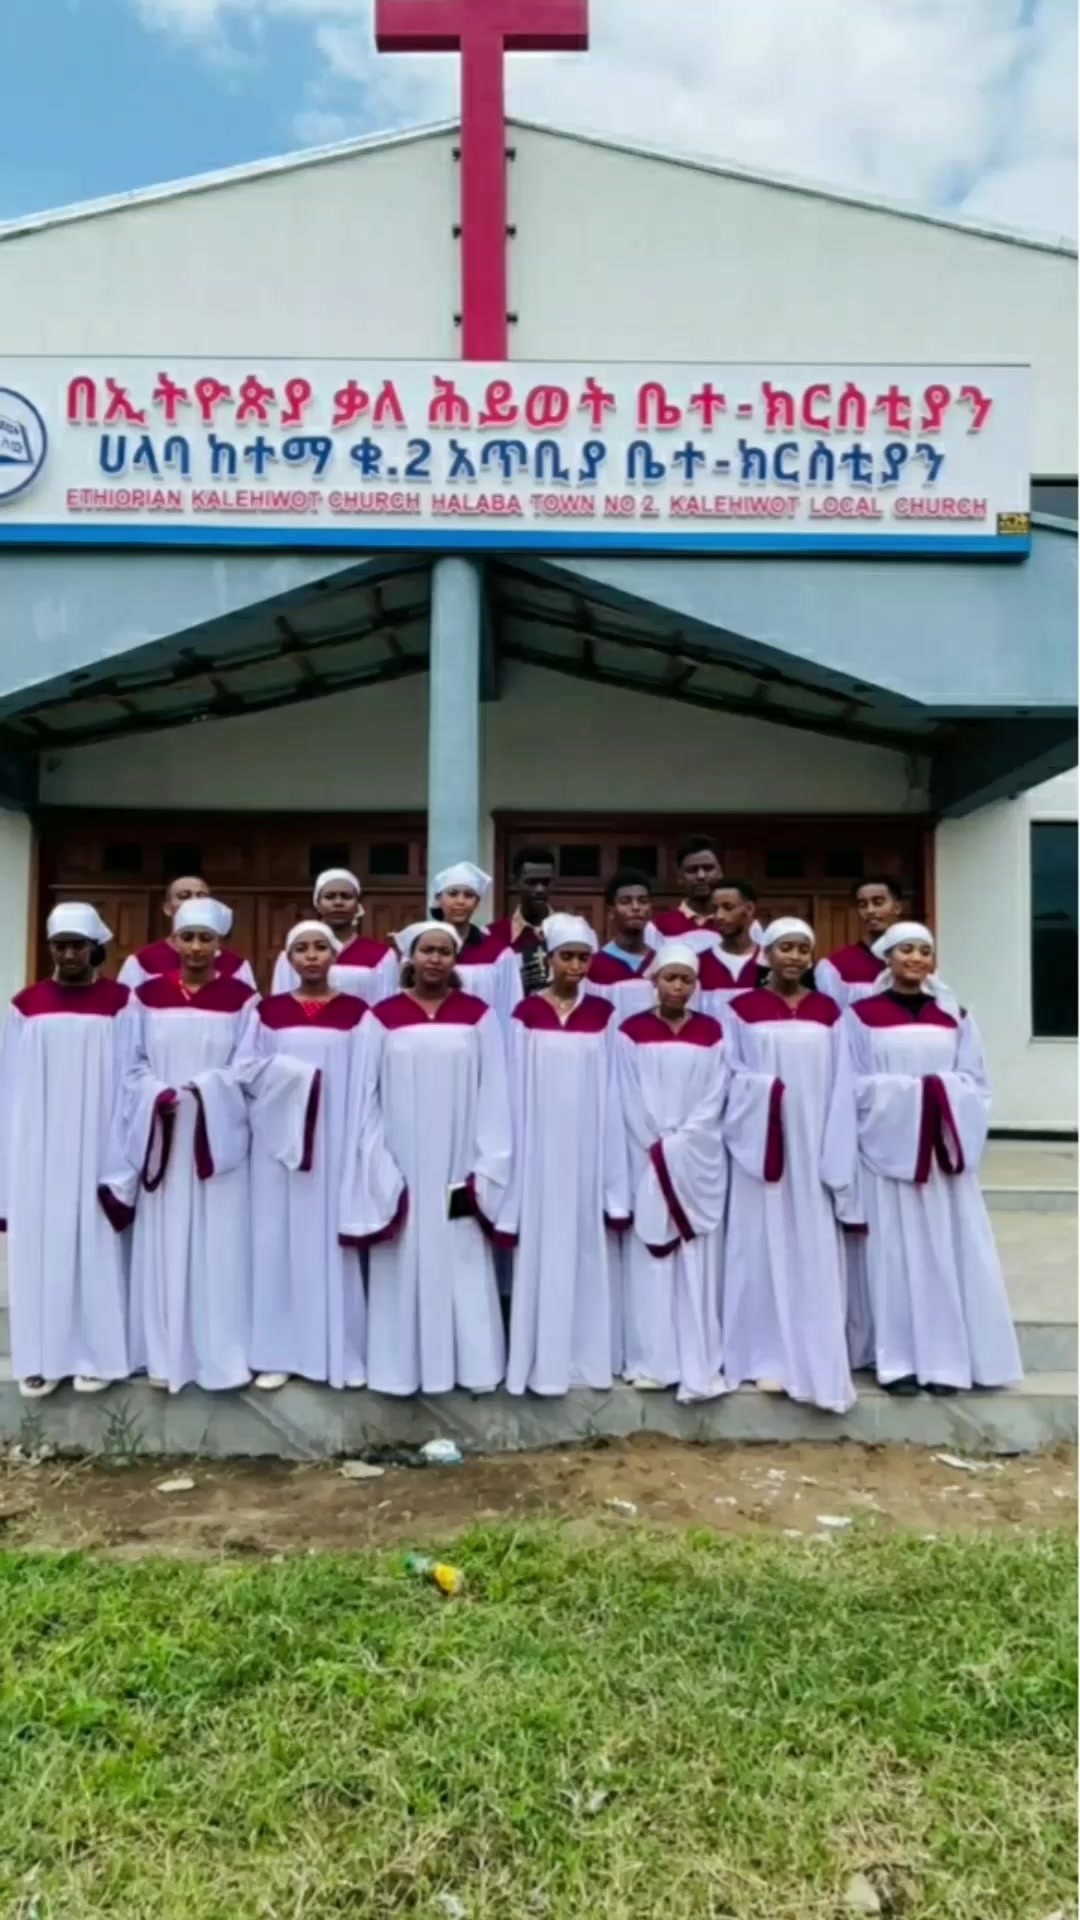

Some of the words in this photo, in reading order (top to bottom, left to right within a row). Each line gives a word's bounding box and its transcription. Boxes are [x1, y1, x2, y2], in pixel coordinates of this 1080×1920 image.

[67, 374, 313, 426] በኢትዮጵያ
[333, 380, 406, 426] ቃለ
[428, 376, 617, 429] ሕይወት
[637, 379, 994, 432] ቤተ-ክርስቲያን
[99, 434, 190, 476] ሀላባ
[207, 433, 333, 477] ከተማ
[350, 436, 432, 479] ቁ.2
[448, 439, 607, 482] አጥቢያ
[626, 438, 945, 485] ቤተ-ክርስቲያን
[67, 488, 182, 511] ETHIOPIAN
[192, 489, 321, 511] KALEHIWOT
[329, 491, 421, 513] CHURCH
[431, 493, 522, 514] HALABA
[531, 493, 595, 514] TOWN
[604, 494, 636, 515] NO
[669, 495, 799, 517] KALEHIWOT
[809, 496, 882, 518] LOCAL
[894, 496, 987, 519] CHURCH
